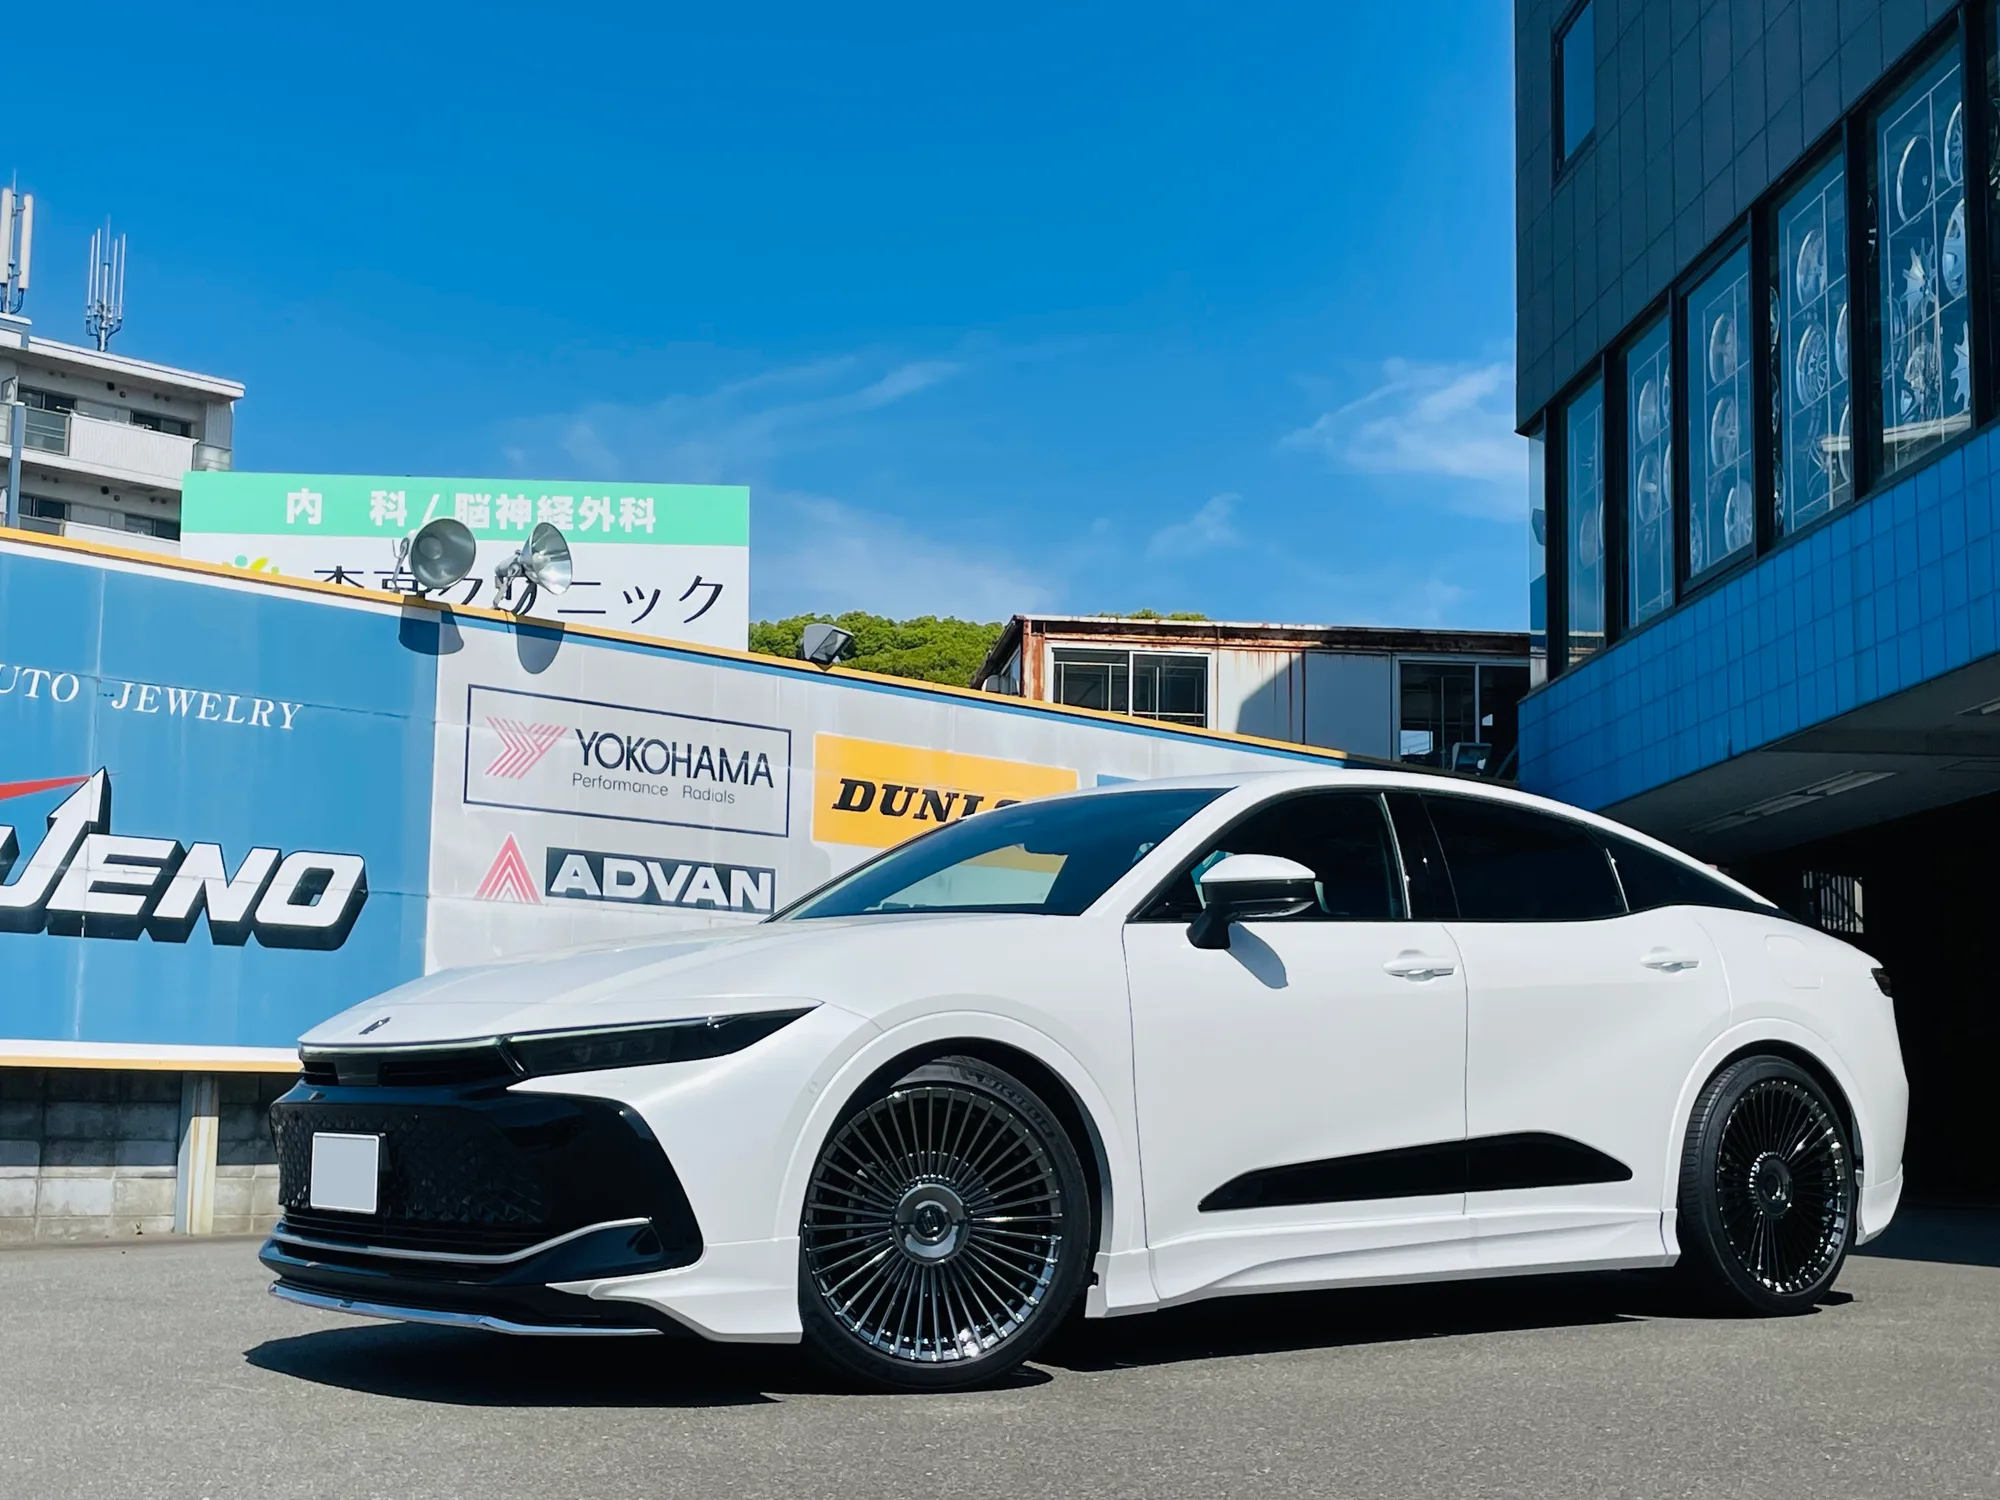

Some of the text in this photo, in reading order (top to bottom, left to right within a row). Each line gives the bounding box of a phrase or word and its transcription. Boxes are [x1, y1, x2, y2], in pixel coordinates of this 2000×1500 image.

[111, 681, 304, 730] JEWELRY
[575, 728, 775, 788] YOKOHAMA
[572, 772, 735, 804] Performance Radials
[832, 777, 1021, 823] DUNL
[550, 853, 773, 911] ADVAN
